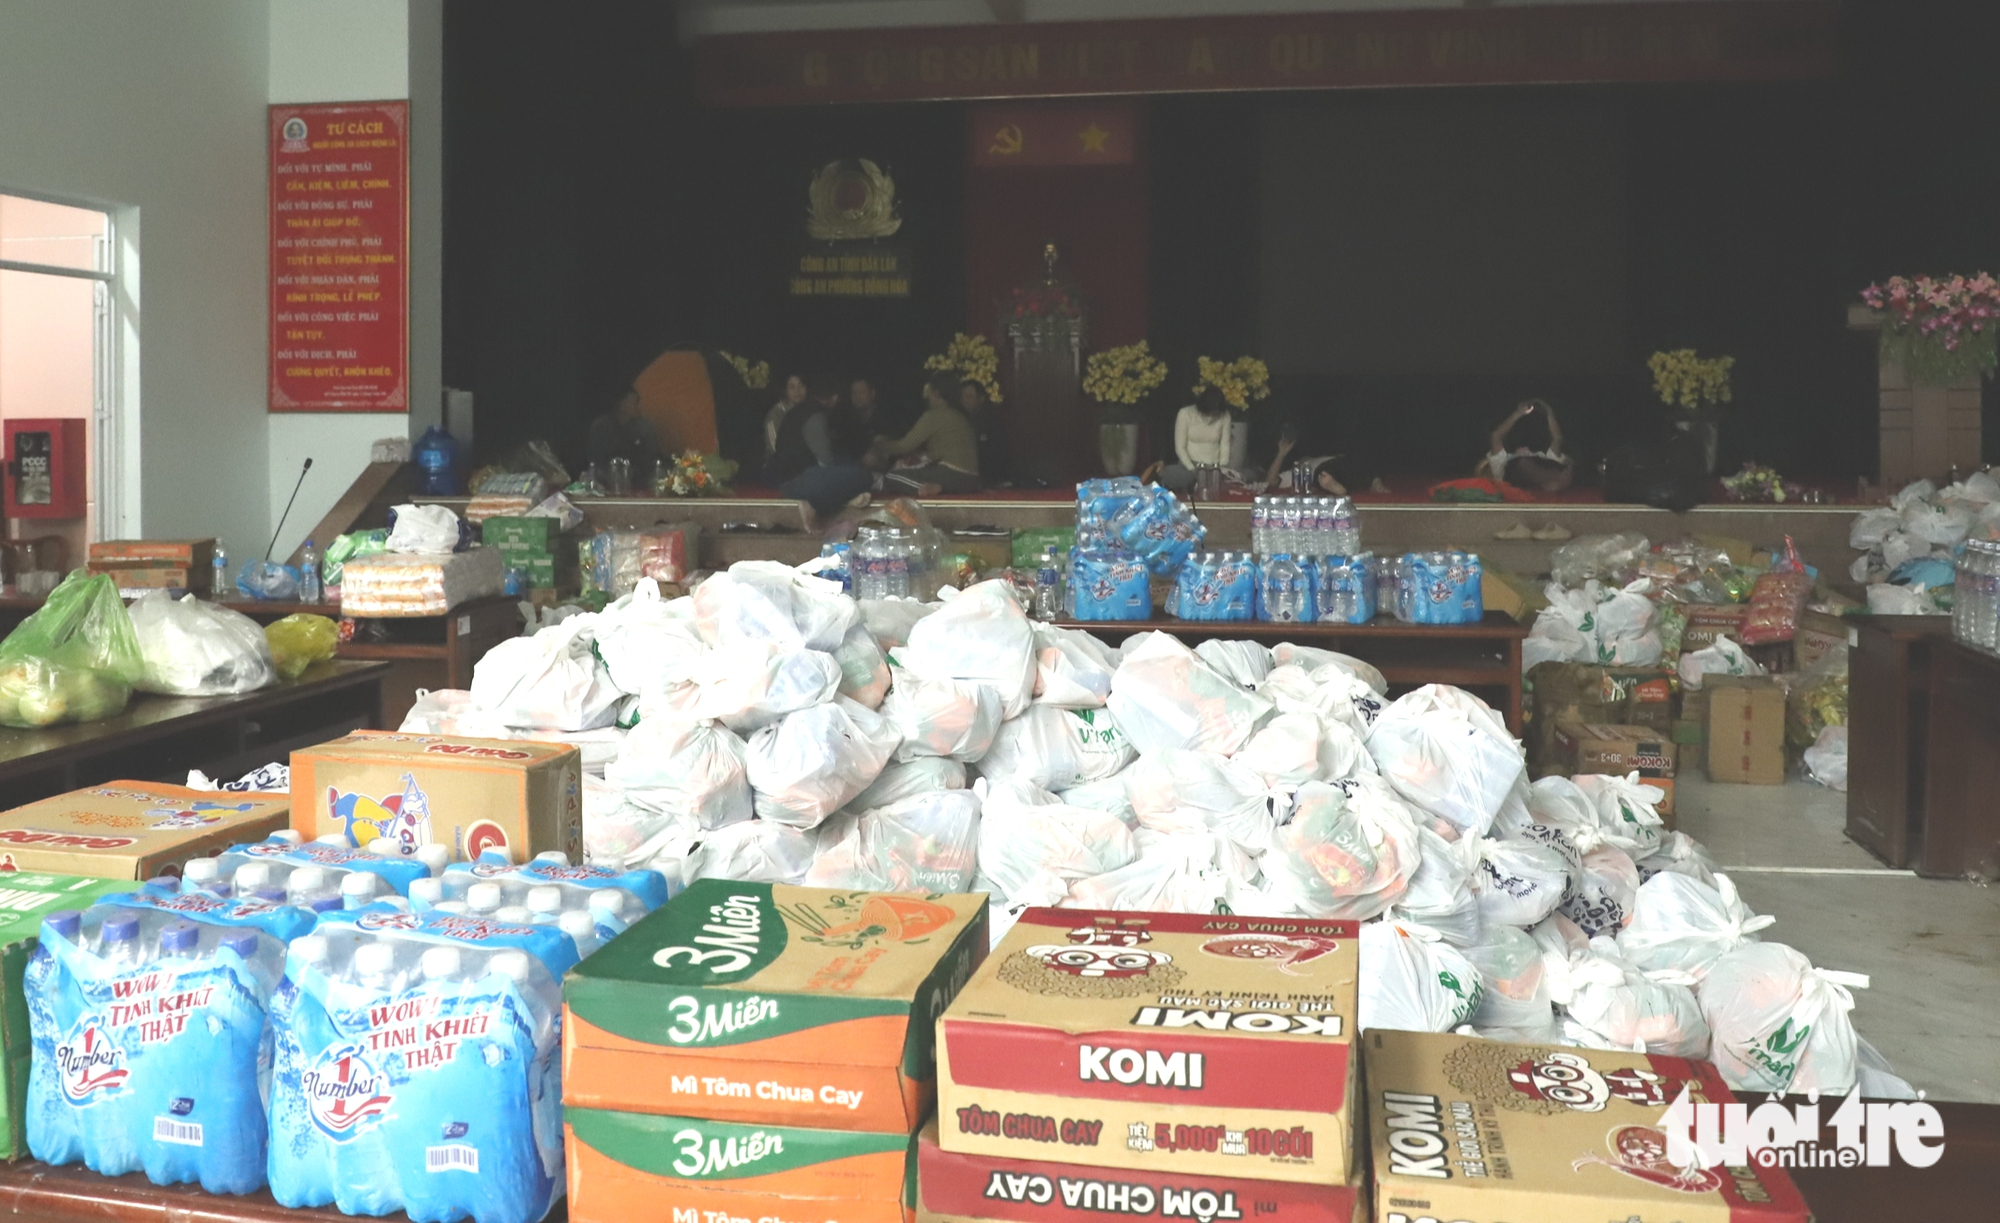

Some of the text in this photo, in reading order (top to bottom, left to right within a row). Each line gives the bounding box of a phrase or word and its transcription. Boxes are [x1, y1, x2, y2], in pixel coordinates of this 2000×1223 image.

[327, 120, 383, 135] TƯ CÁCH
[22, 457, 47, 467] PCCC
[1600, 753, 1672, 768] 30+3 KOKOMI
[1202, 921, 1345, 935] TÔM CHUA CAY
[110, 1000, 151, 1027] TINH
[140, 1013, 189, 1043] THẬT
[1131, 1006, 1343, 1036] KOMI
[367, 1008, 492, 1051] TINH KHIẾT
[405, 1041, 458, 1069] THẬT
[1079, 1044, 1205, 1089] KOMI
[304, 1068, 382, 1101] Number
[671, 1075, 863, 1110] Mì Tôm Chua Cay
[957, 1104, 1104, 1147] TÔM CHUA CAY
[1225, 1130, 1244, 1144] KHI
[1383, 1090, 1454, 1179] KOMI
[1221, 1142, 1247, 1157] MUA
[986, 1171, 1053, 1205] CAY
[1060, 1179, 1157, 1215] CHUA
[673, 1206, 698, 1223] Mì
[1162, 1187, 1243, 1223] TÔM
